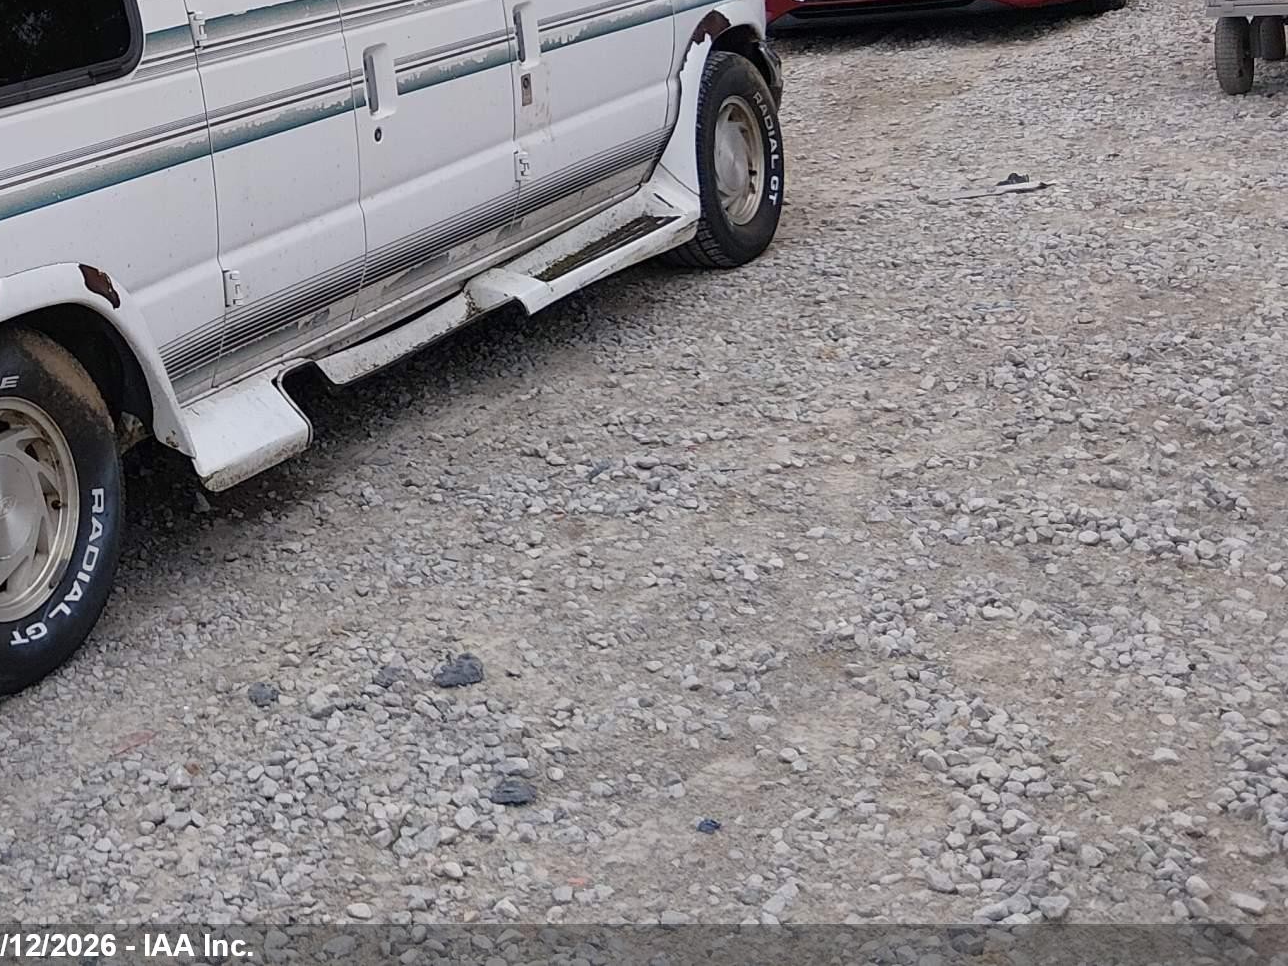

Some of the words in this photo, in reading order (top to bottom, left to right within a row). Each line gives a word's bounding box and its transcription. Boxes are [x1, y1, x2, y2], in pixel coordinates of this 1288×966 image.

[752, 91, 781, 170] RADIAL
[768, 175, 781, 207] GT
[48, 488, 105, 619] RADIAL
[10, 621, 49, 646] GT
